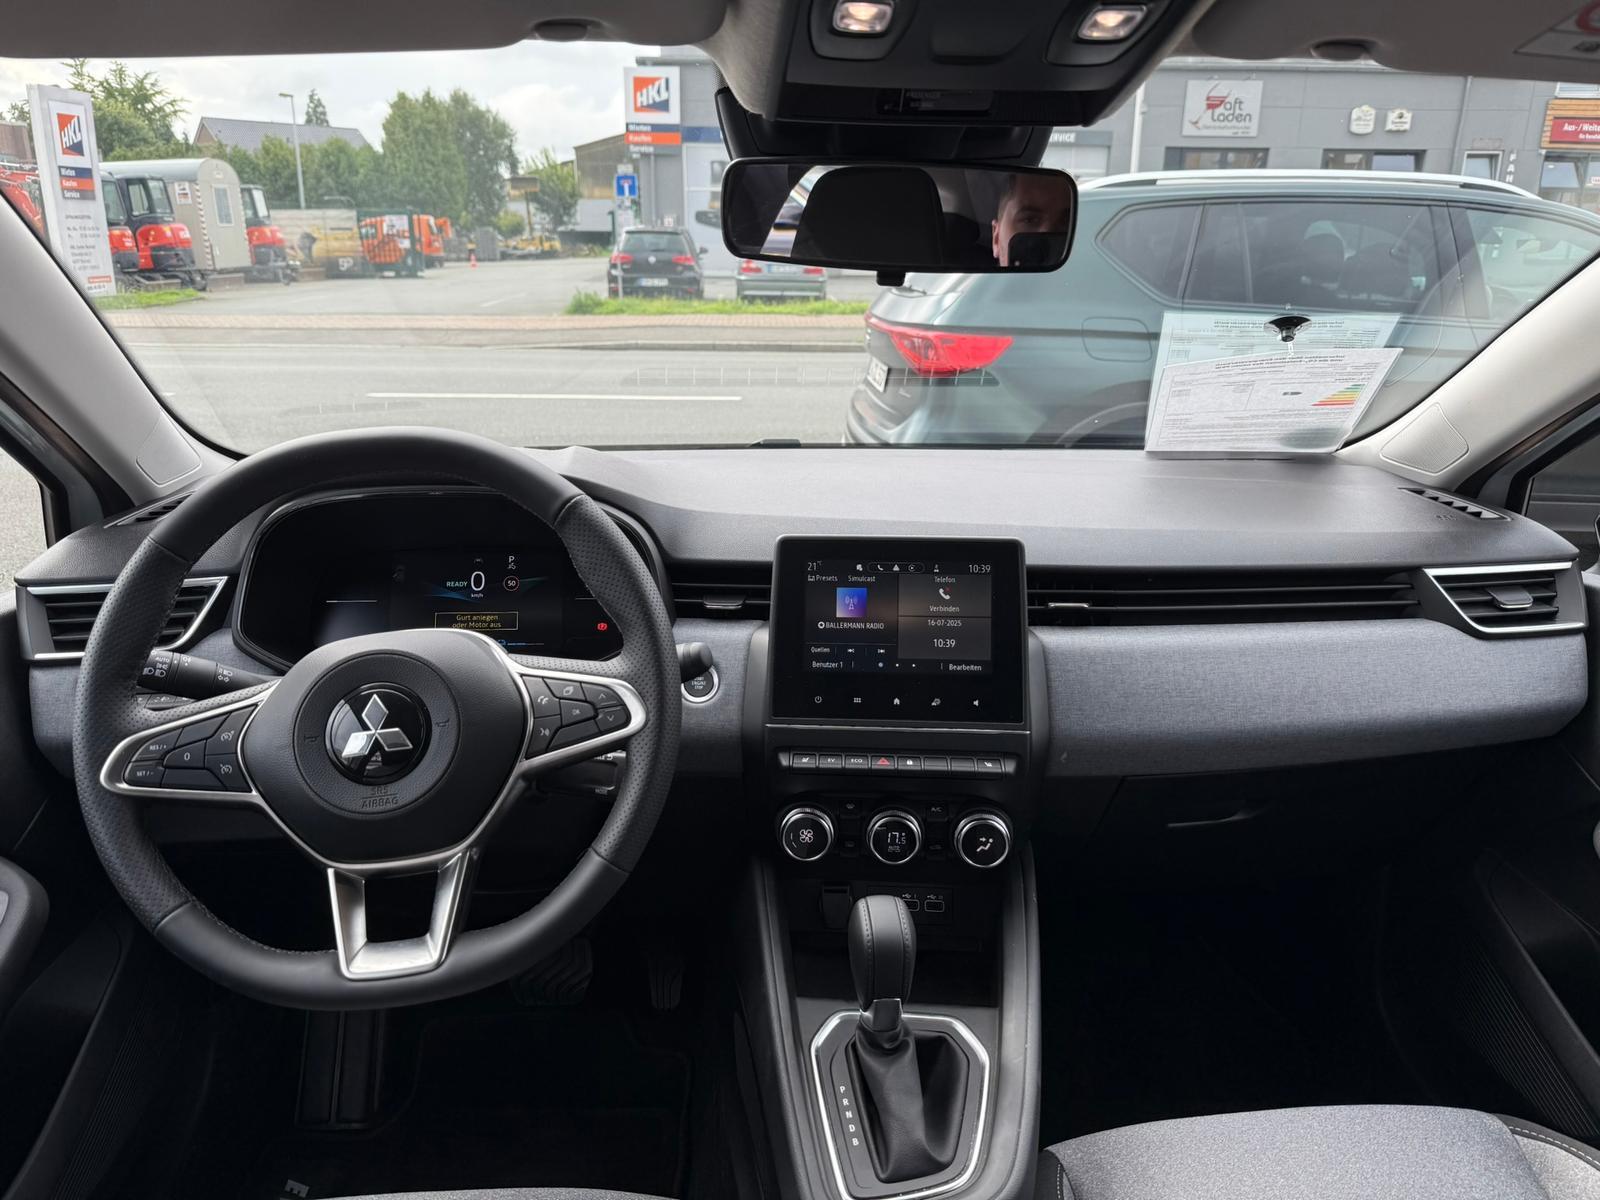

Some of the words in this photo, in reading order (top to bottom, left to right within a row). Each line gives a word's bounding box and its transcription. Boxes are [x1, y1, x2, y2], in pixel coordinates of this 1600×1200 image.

[636, 79, 669, 107] HKL
[61, 115, 82, 149] HKL
[968, 564, 991, 573] 10:39
[471, 571, 485, 591] 0
[848, 575, 876, 583] Simulcast
[929, 605, 960, 613] Verbinden
[472, 614, 498, 623] anlegen
[928, 619, 962, 627] 16-07-2025
[452, 621, 468, 629] oder
[469, 621, 487, 629] Motor
[825, 622, 865, 630] BALLERMANN
[933, 638, 956, 648] 10:39
[812, 661, 840, 669] Benutzer
[361, 796, 399, 809] AIRBAG
